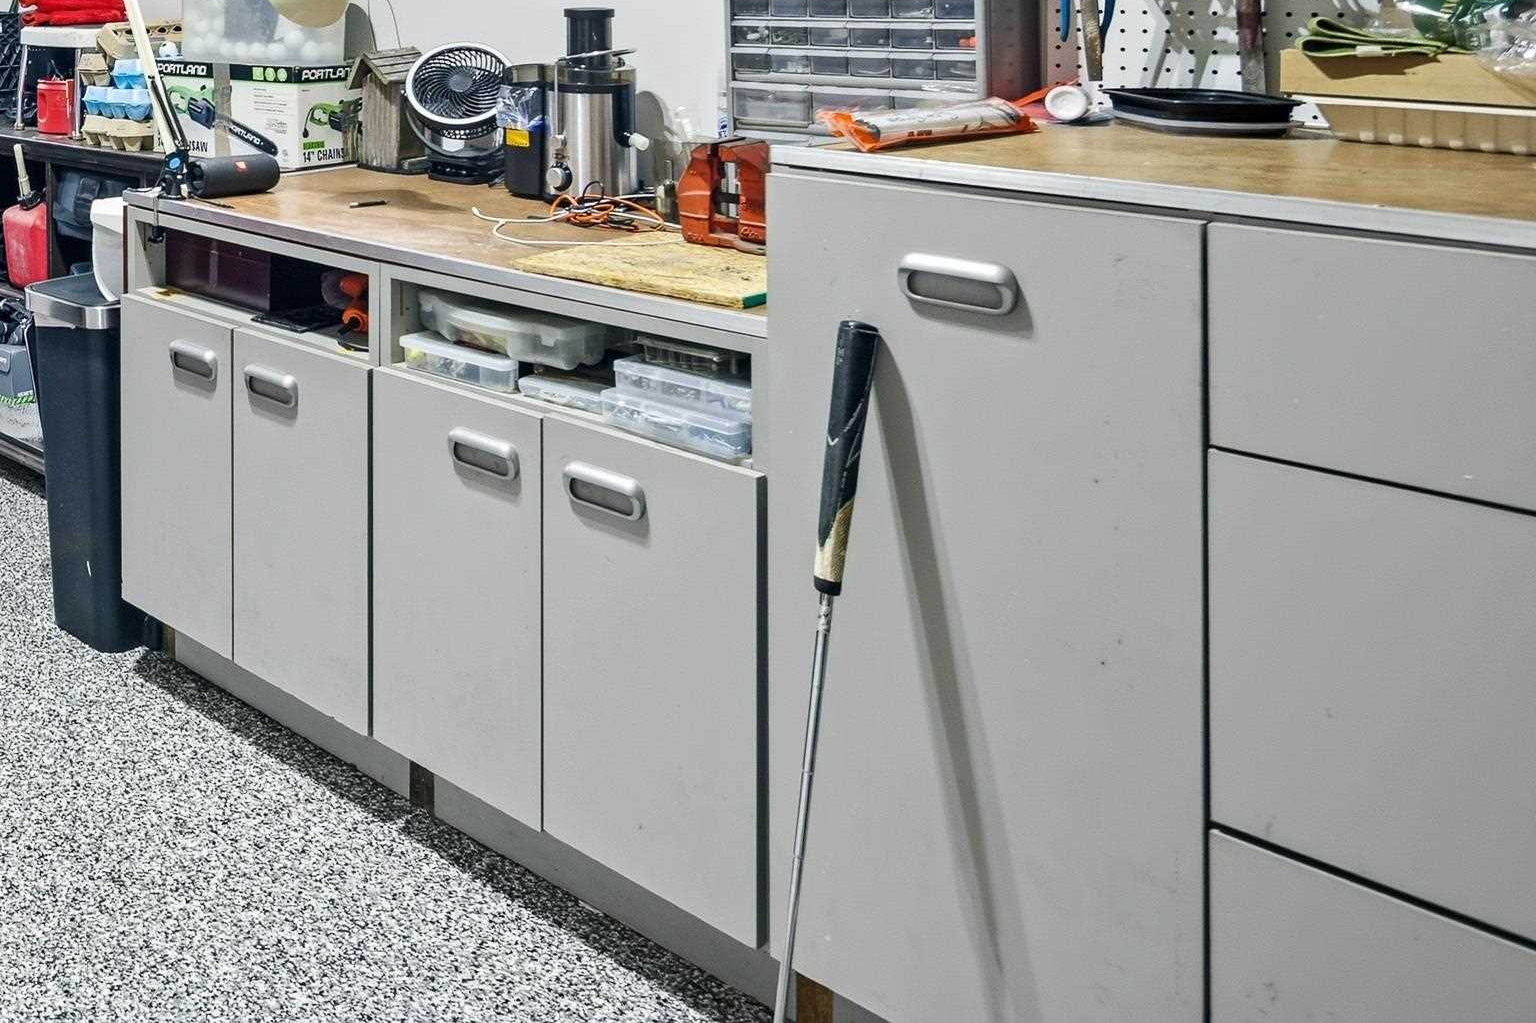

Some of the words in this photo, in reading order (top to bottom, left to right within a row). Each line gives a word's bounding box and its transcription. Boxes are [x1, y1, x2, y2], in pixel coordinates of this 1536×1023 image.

[157, 63, 208, 76] PORTLAND
[302, 67, 352, 81] PORTLAN
[230, 125, 261, 145] ORTLAND
